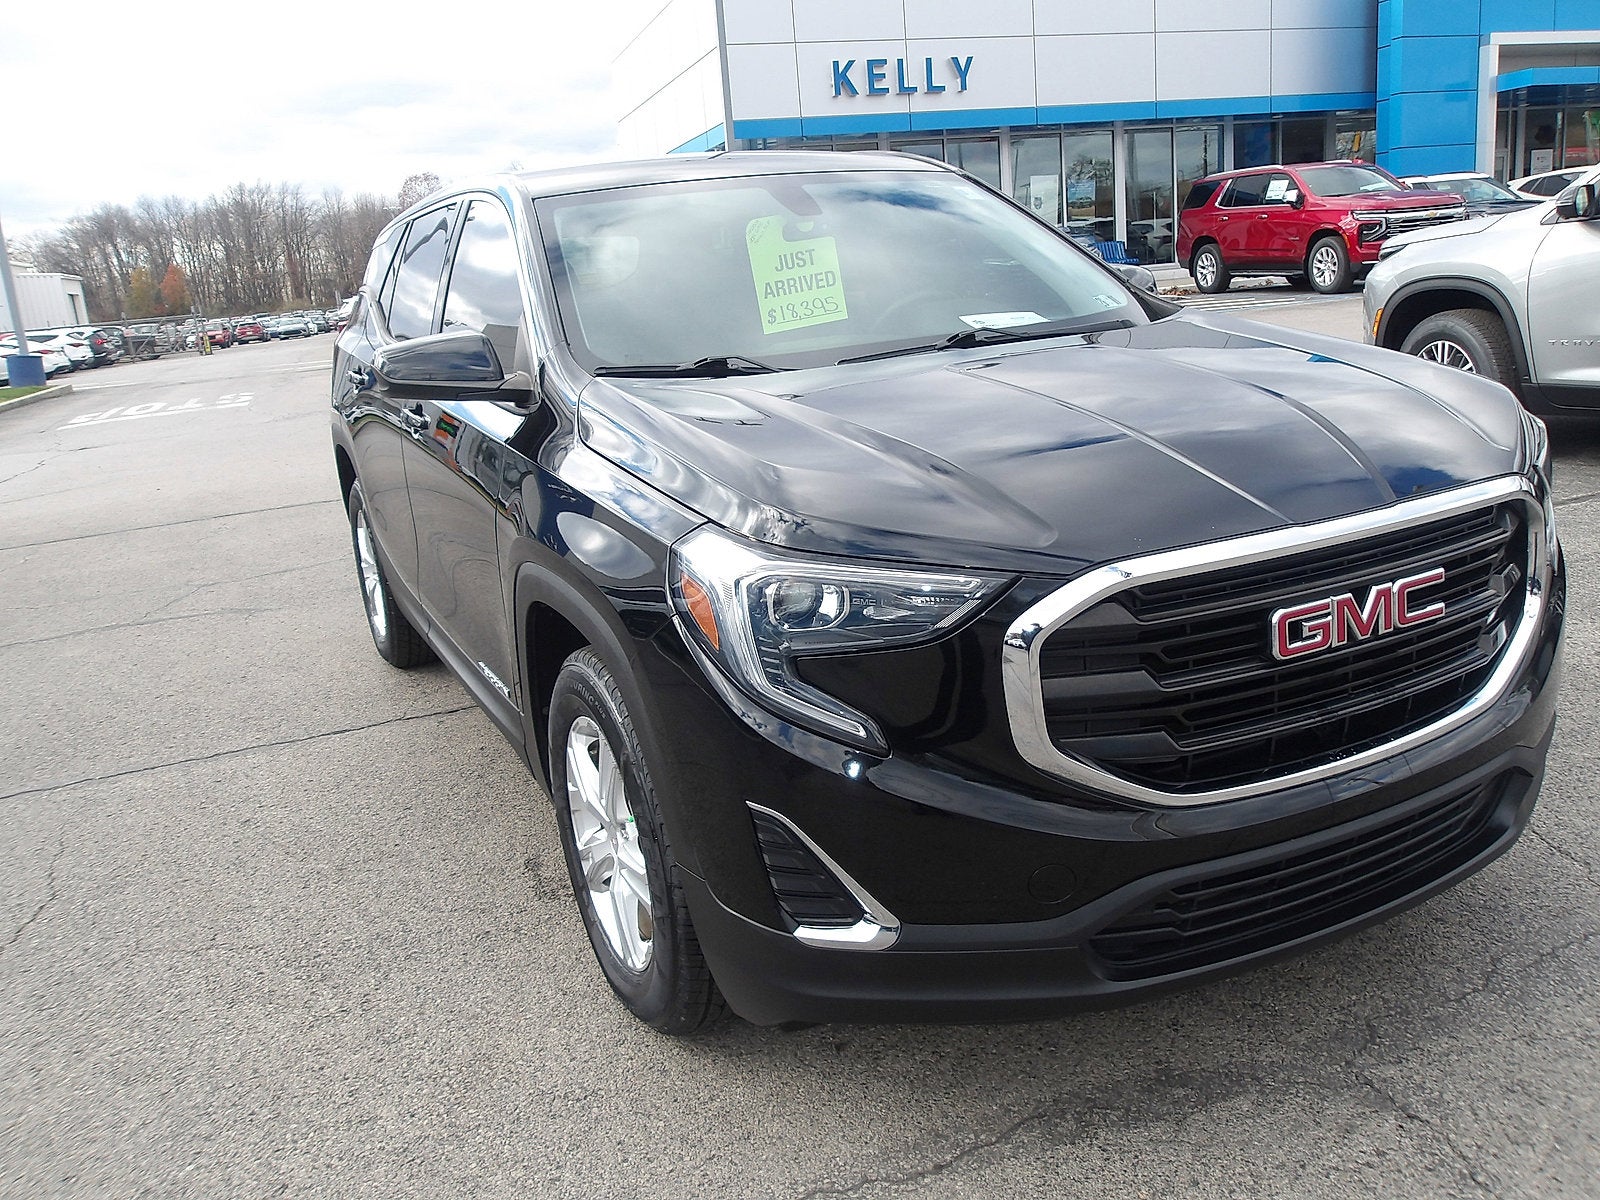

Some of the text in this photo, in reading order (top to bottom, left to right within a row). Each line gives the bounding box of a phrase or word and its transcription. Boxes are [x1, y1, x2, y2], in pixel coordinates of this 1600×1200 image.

[831, 55, 974, 98] KELLY
[774, 248, 816, 273] JUST
[763, 270, 837, 300] ARRIVED
[766, 296, 840, 326] $18,395
[852, 597, 877, 606] GMC
[1271, 567, 1446, 661] GMC
